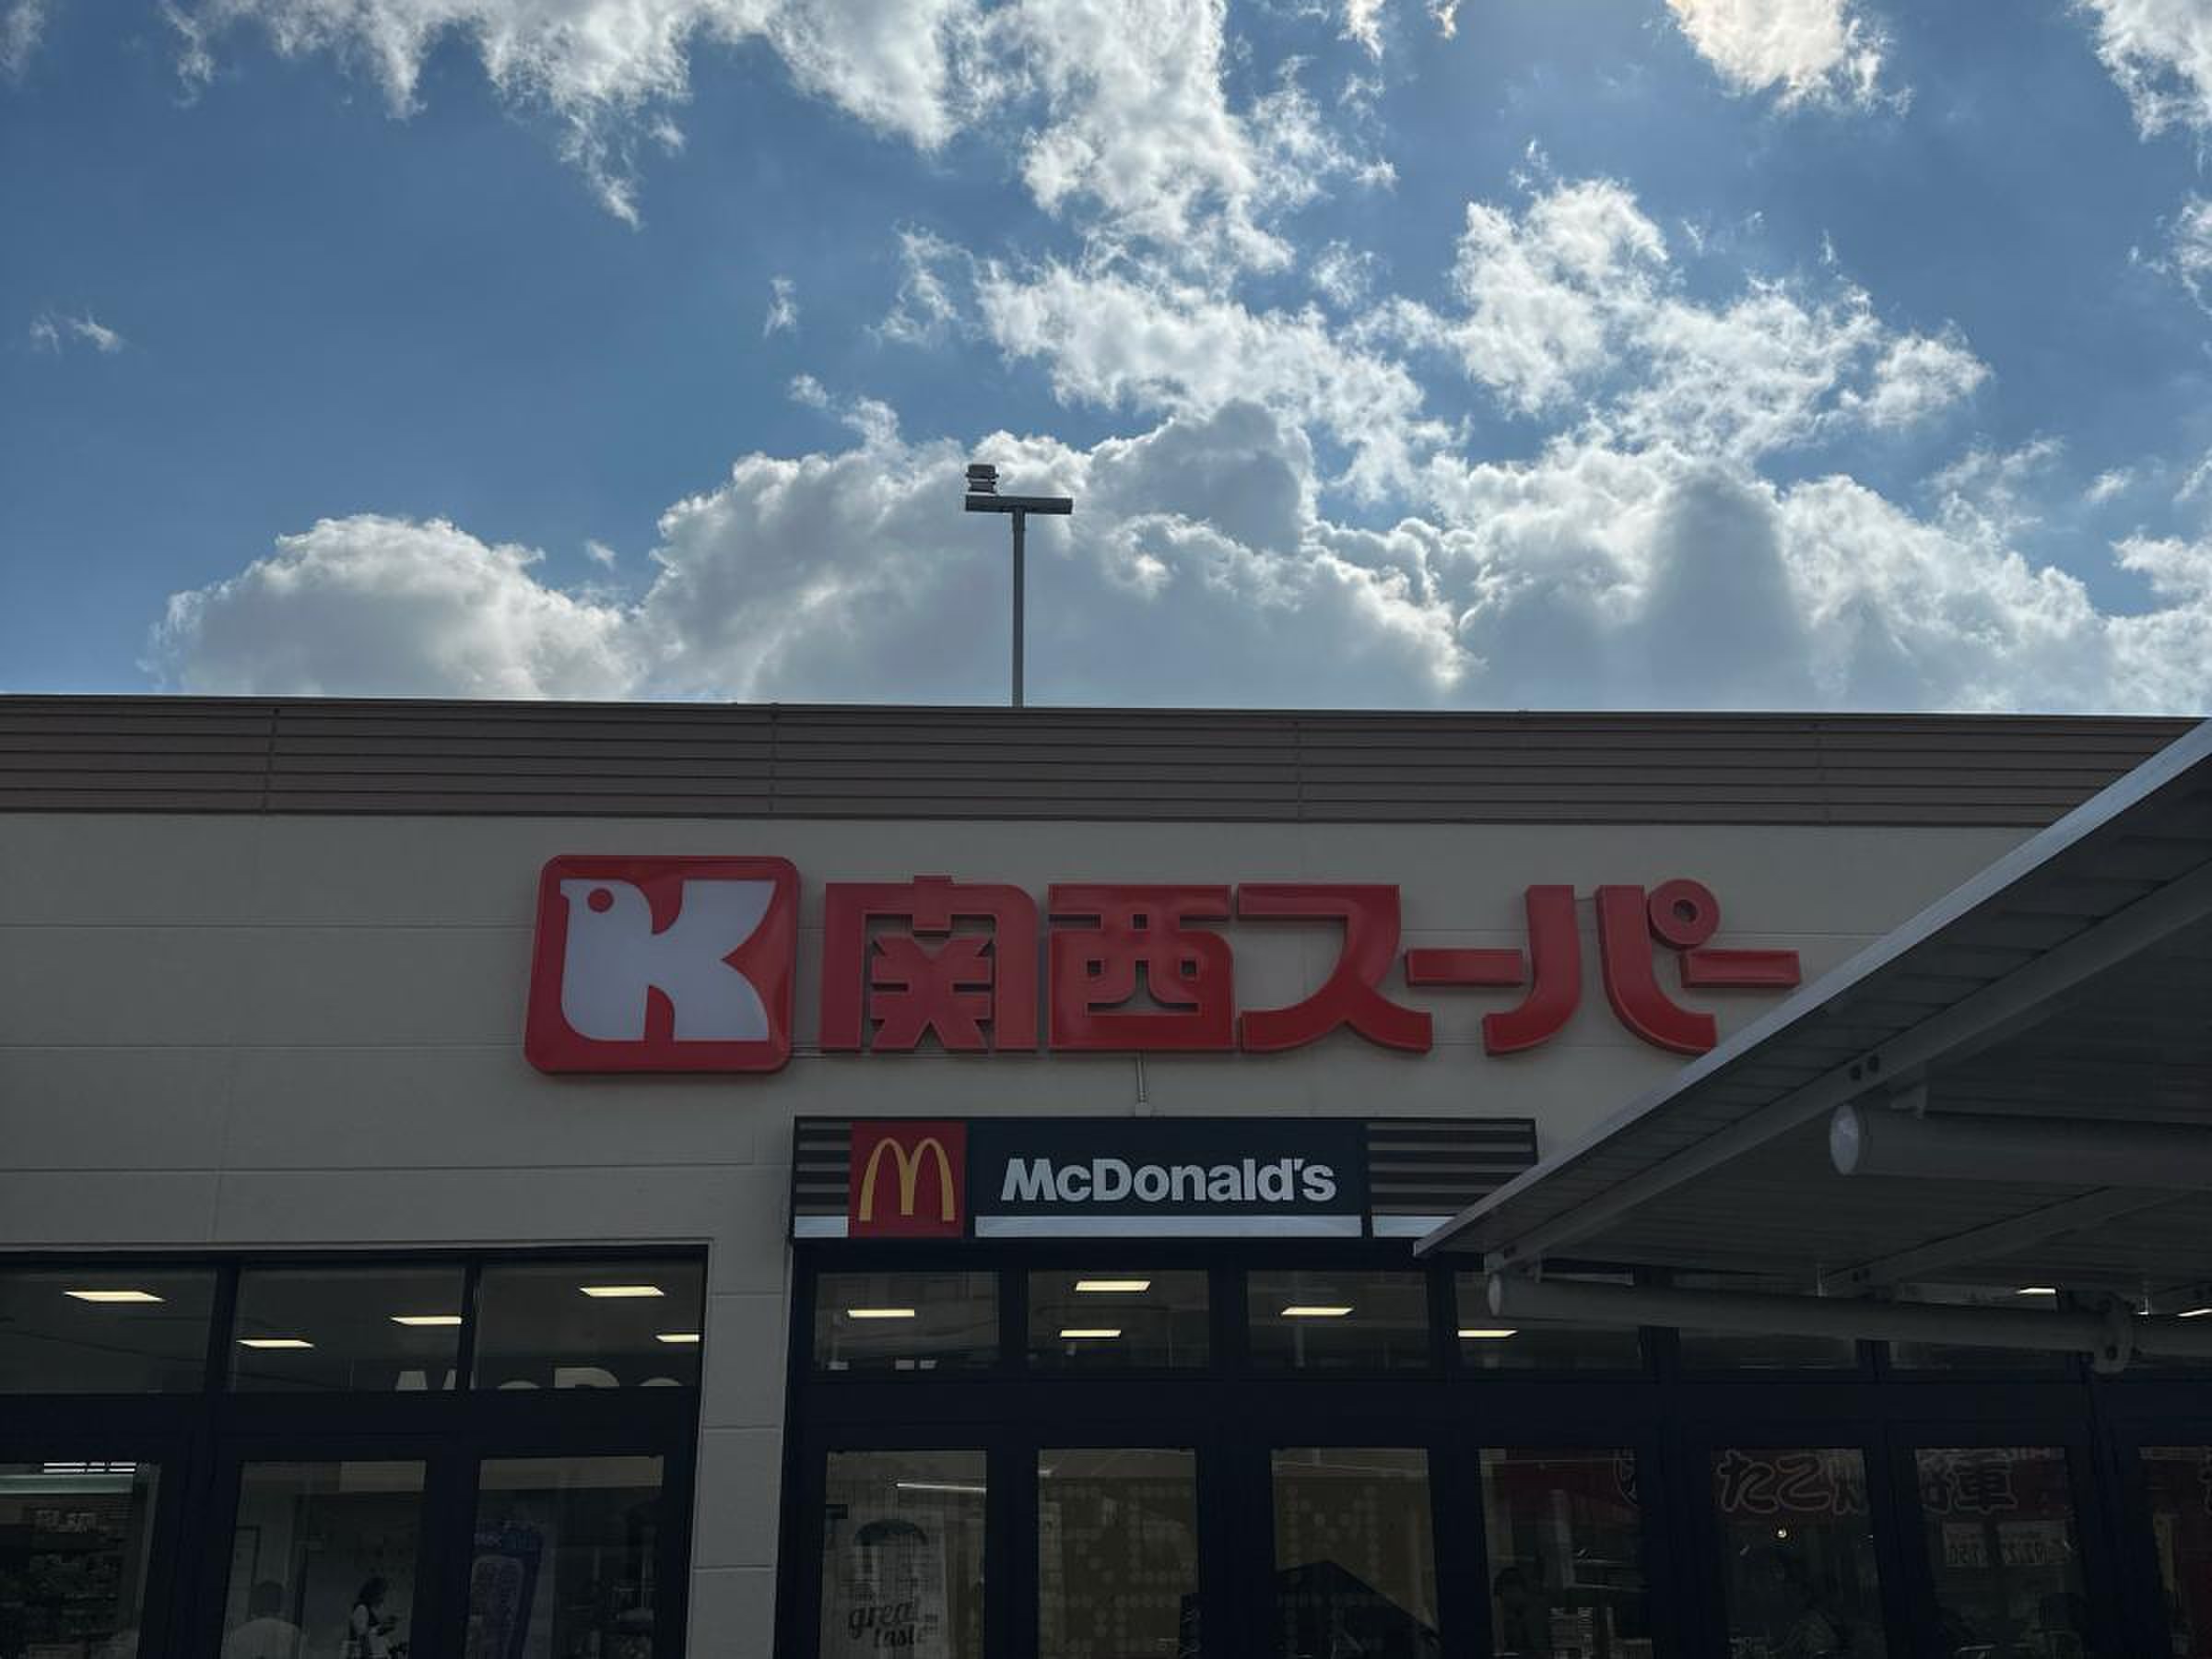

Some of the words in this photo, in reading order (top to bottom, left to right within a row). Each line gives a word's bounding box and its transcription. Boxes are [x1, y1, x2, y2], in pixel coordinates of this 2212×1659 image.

[822, 877, 1800, 1054] 関西スーパー
[1000, 1157, 1337, 1203] McDonald's
